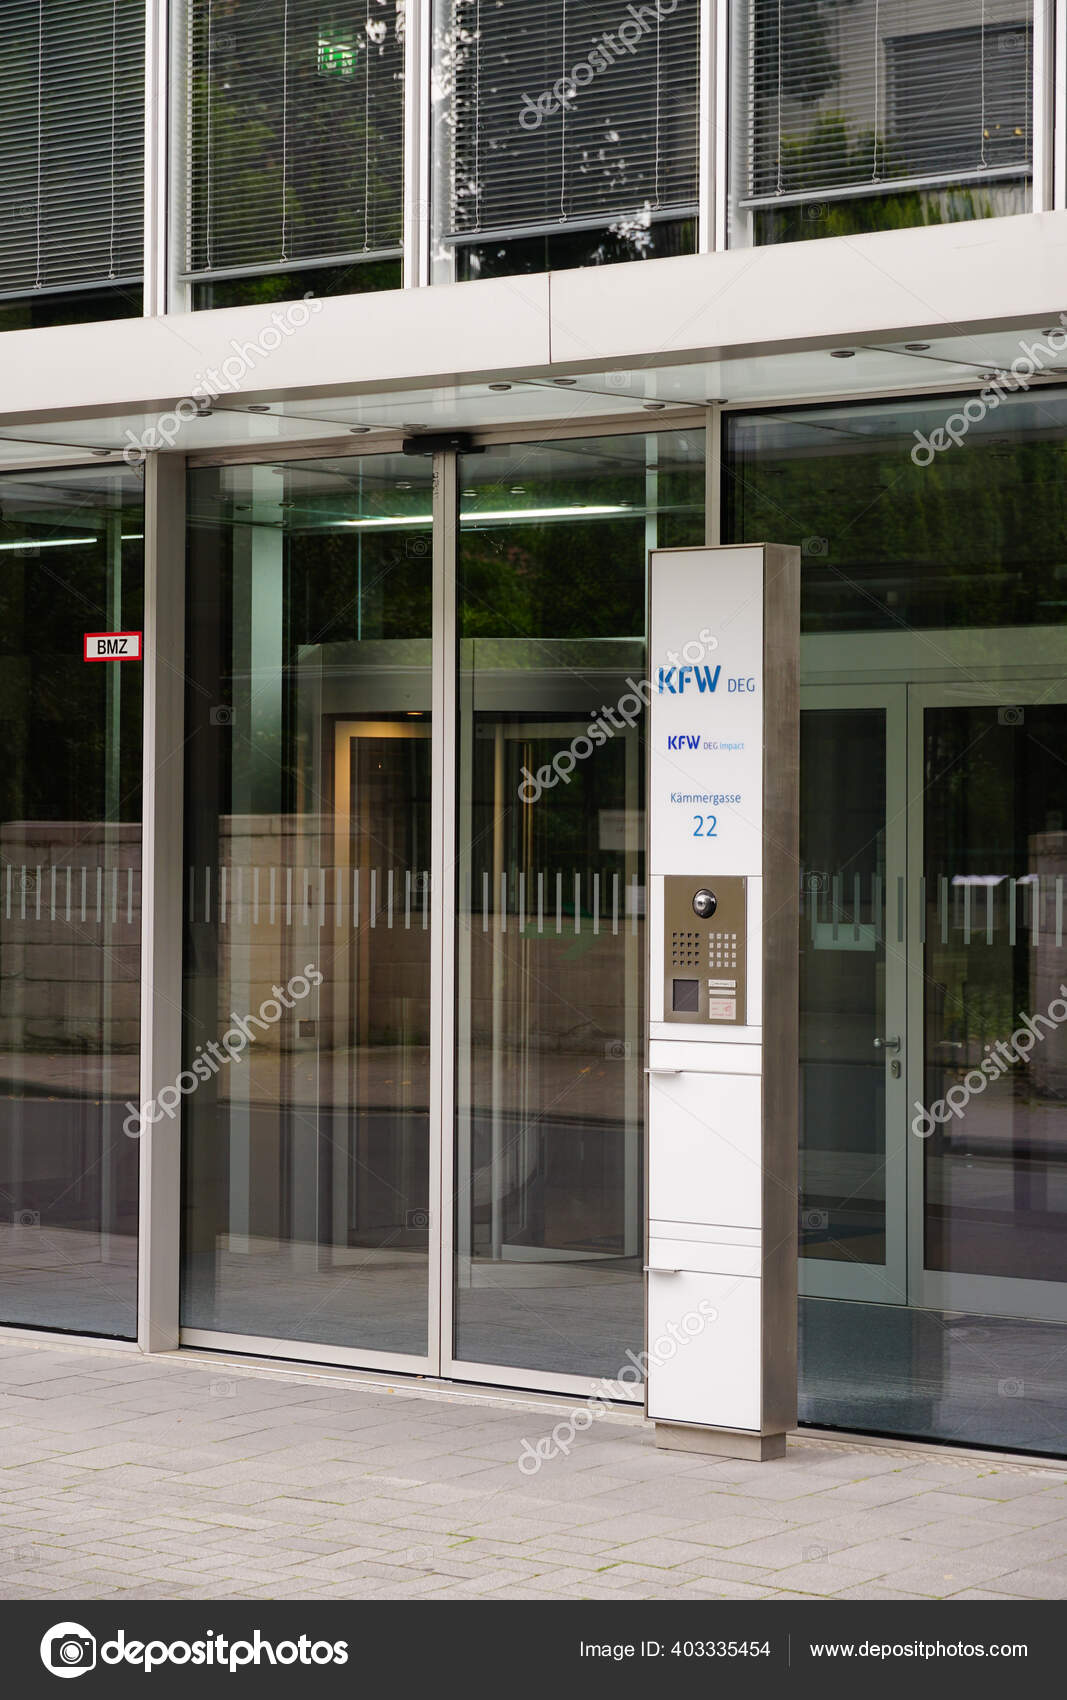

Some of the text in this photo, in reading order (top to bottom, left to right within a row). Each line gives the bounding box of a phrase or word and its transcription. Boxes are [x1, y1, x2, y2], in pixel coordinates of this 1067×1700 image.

[97, 639, 128, 655] BMZ
[727, 677, 755, 692] DEG
[703, 742, 718, 750] DEG
[670, 791, 742, 806] Kämmergasse
[693, 815, 718, 837] 22
